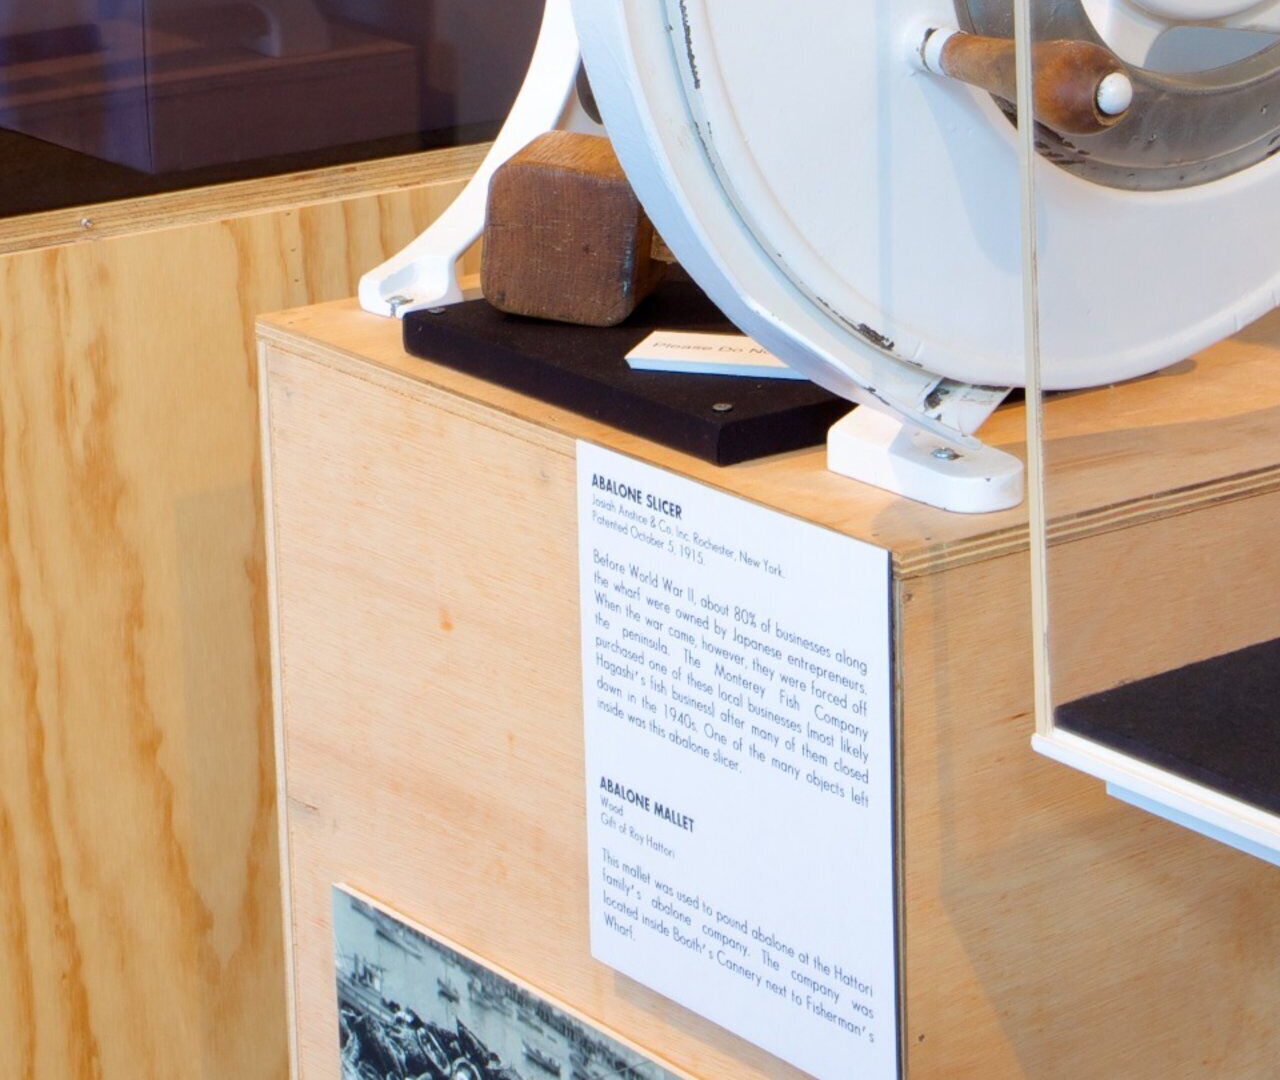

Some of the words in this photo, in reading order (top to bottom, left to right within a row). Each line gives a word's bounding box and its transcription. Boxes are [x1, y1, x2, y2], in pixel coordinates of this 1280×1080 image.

[653, 341, 713, 351] Please
[718, 346, 743, 354] Do
[591, 472, 642, 505] ABALONE
[645, 493, 682, 520] SLICER
[592, 548, 626, 574] Before
[628, 563, 658, 588] World
[662, 576, 683, 598] War
[687, 586, 696, 605] II,
[700, 594, 729, 616] about
[733, 605, 757, 628] 80%
[760, 618, 771, 634] of
[775, 621, 831, 658] businesses
[835, 649, 868, 676] along
[593, 571, 609, 588] the
[613, 580, 640, 600] wharf
[646, 596, 670, 614] were
[675, 608, 709, 630] owned
[713, 618, 727, 640] by
[732, 626, 782, 660] Japanese
[787, 654, 867, 695] entrepreneurs.
[594, 590, 622, 613] When
[625, 604, 641, 622] the
[644, 616, 664, 631] war
[668, 626, 697, 648] came,
[701, 636, 747, 669] however,
[752, 657, 775, 681] they
[779, 673, 807, 692] were
[811, 680, 847, 709] forced
[851, 699, 867, 717] off
[594, 612, 610, 629] the
[683, 647, 701, 669] The
[714, 662, 766, 699] Monterey
[779, 688, 800, 711] Fish
[814, 704, 869, 742] Company
[595, 636, 645, 665] purchased
[648, 660, 668, 675] one
[671, 666, 682, 681] of
[686, 671, 714, 696] these
[718, 683, 743, 707] local
[747, 697, 802, 734] businesses
[840, 736, 869, 764] likely
[599, 775, 650, 812] ABALONE
[653, 800, 695, 833] MALLET
[600, 796, 624, 816] Wood
[601, 847, 619, 869] This
[622, 863, 650, 884] mallet
[654, 879, 674, 897] was
[676, 891, 700, 910] used
[702, 901, 713, 916] to
[715, 911, 748, 935] pound
[751, 925, 795, 958] abalone
[798, 952, 809, 965] at
[812, 955, 831, 976] the
[834, 964, 873, 997] Hattori
[603, 889, 639, 921] located
[641, 914, 670, 937] inside
[716, 949, 762, 987] Cannery
[765, 979, 787, 998] next
[791, 989, 802, 1006] to
[651, 896, 691, 926] abalone
[701, 924, 750, 957] company.
[761, 948, 780, 971] The
[790, 969, 840, 1004] company
[851, 1000, 874, 1019] was
